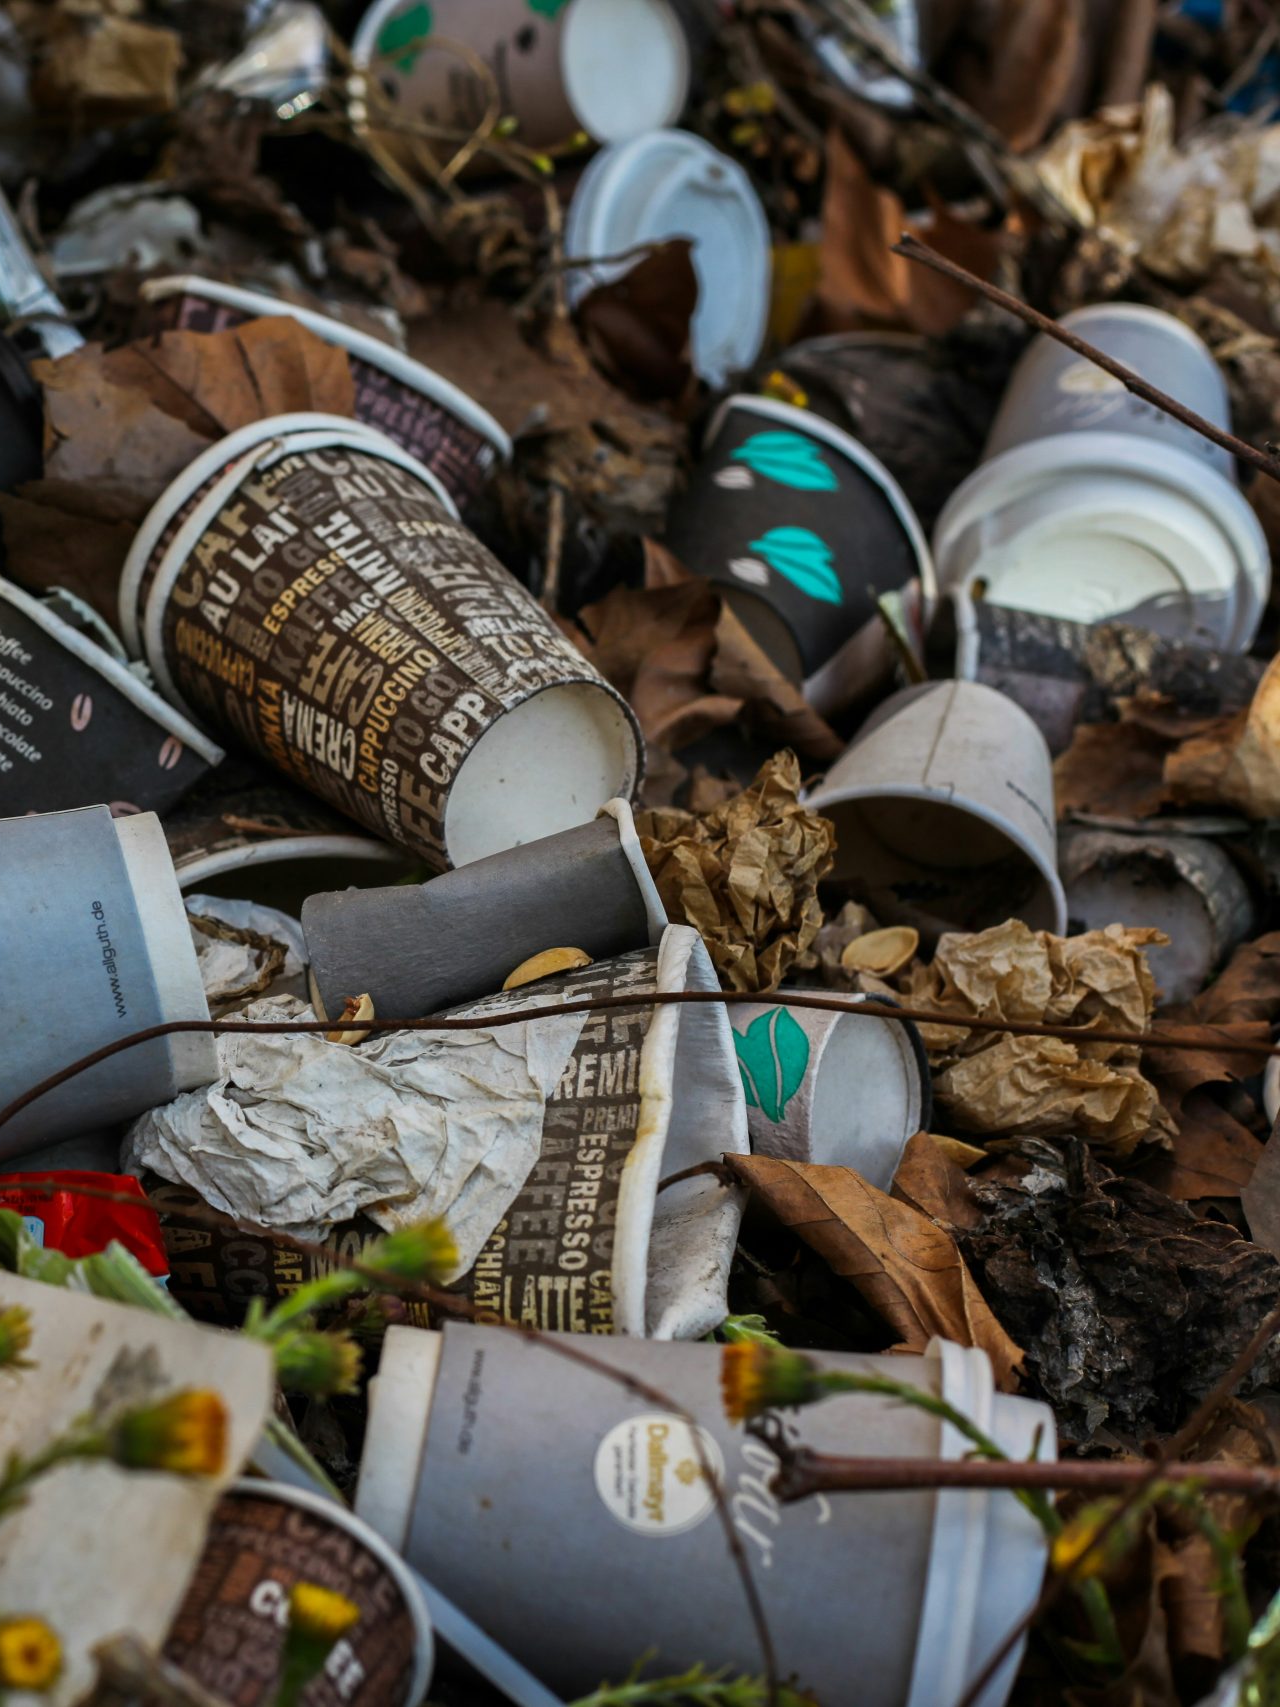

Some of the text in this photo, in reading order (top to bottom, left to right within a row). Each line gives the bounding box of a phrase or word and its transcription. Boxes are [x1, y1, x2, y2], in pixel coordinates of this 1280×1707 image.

[199, 568, 241, 635] AU
[230, 500, 300, 573] LAI
[237, 567, 286, 616] TO
[298, 631, 384, 728] CAFE
[357, 648, 439, 794] CAPPUCCINO
[385, 671, 458, 764] TO GO
[282, 689, 356, 781] CREMA
[90, 900, 128, 1019] www.allguth.de
[581, 1102, 640, 1132] PREMI
[557, 1132, 609, 1272] ESPRESSO
